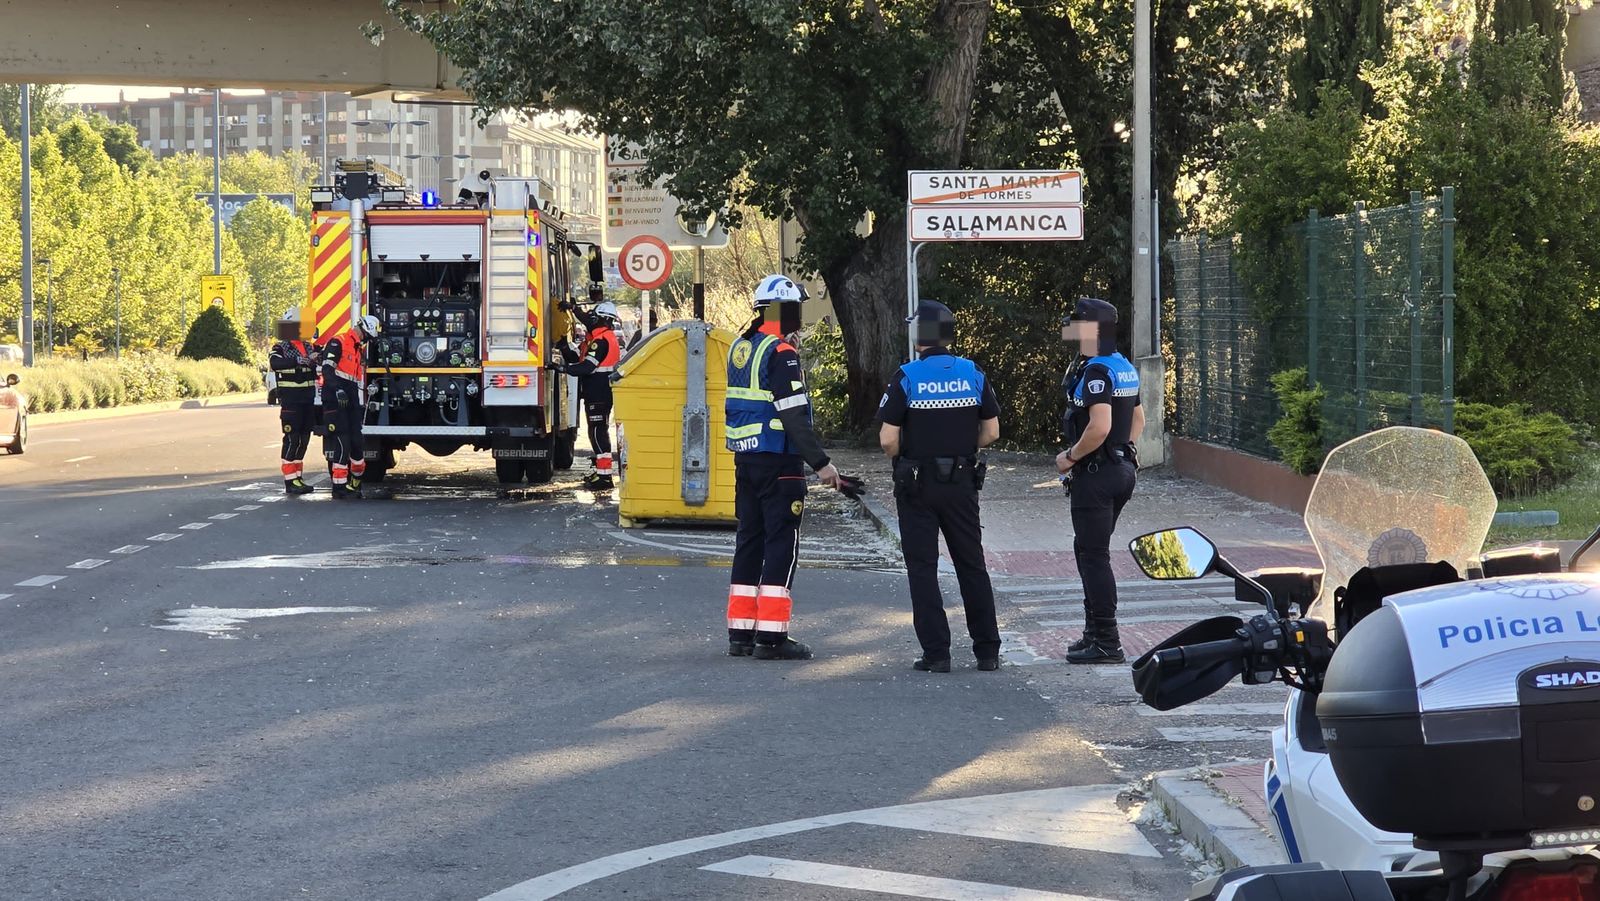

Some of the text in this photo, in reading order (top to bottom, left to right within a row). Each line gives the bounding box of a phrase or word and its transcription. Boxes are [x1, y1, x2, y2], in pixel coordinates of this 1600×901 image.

[929, 175, 1062, 188] SANTA MARTA
[959, 190, 1032, 200] DE TORMES
[927, 214, 1067, 231] SALAMANCA
[631, 254, 660, 272] 50
[775, 289, 790, 297] 161
[917, 377, 971, 394] POLICÍA
[493, 443, 549, 457] rosenbauer
[1576, 610, 1600, 632] L
[1536, 670, 1600, 688] SHAD
